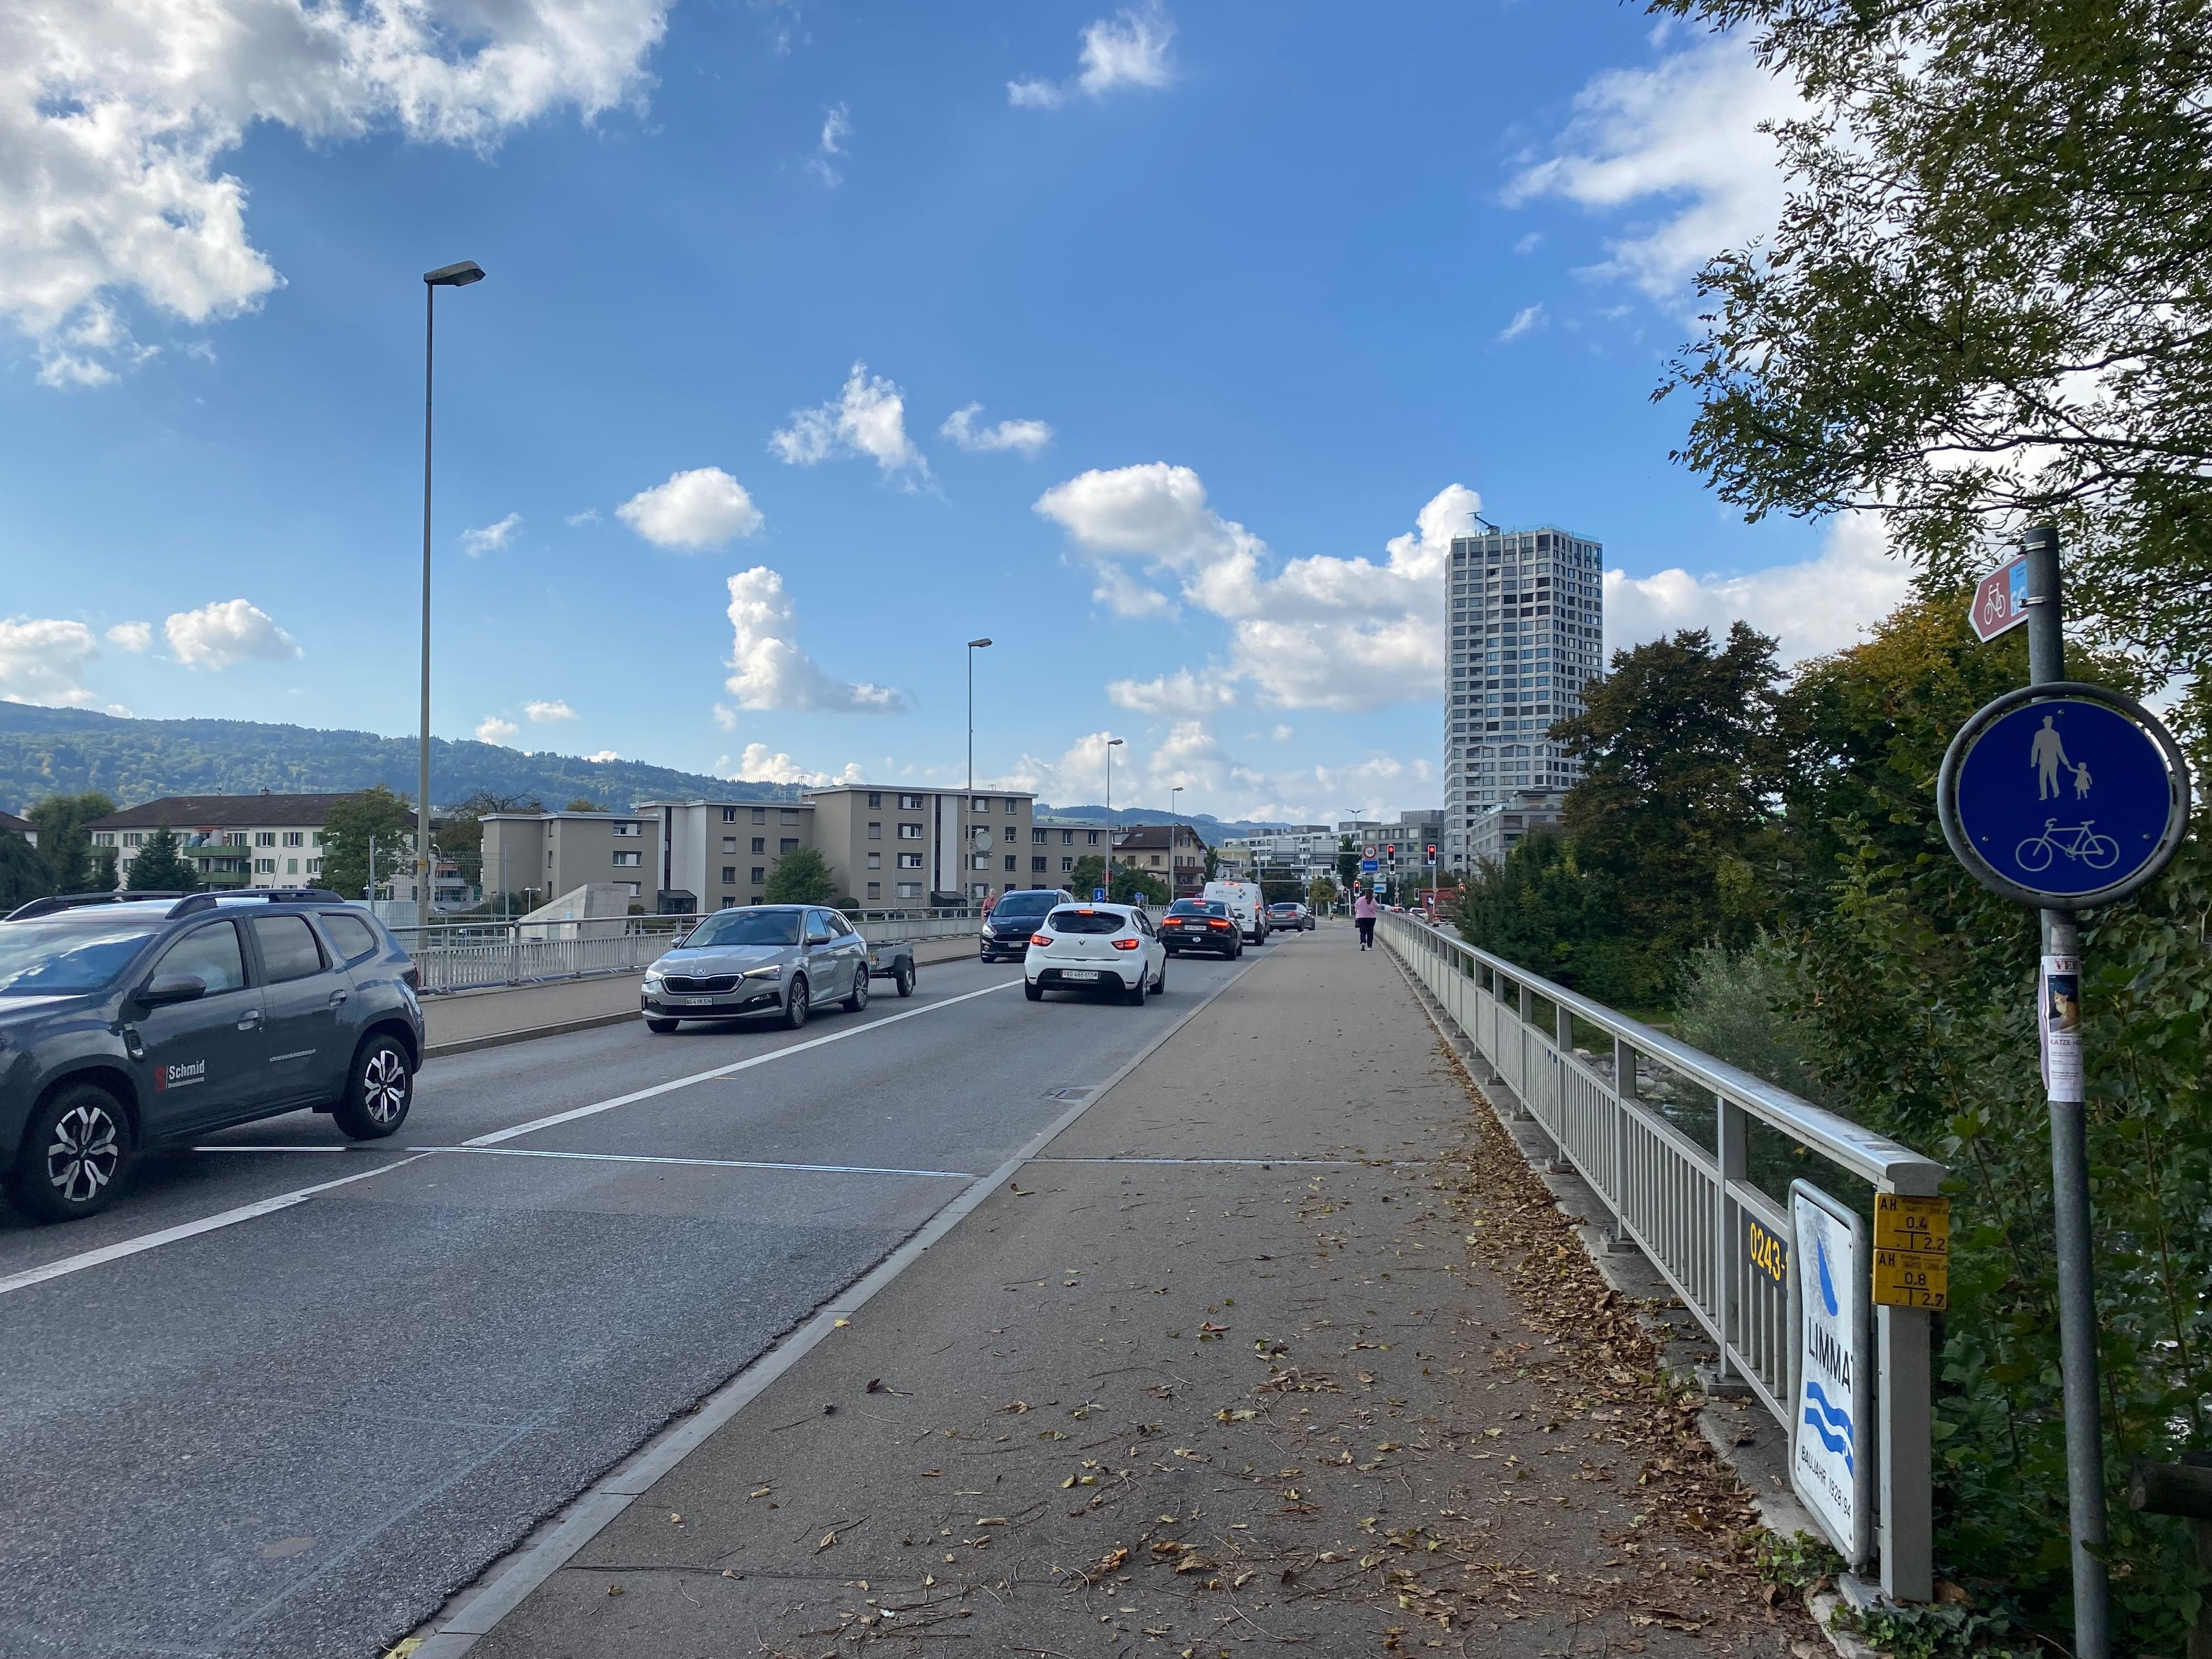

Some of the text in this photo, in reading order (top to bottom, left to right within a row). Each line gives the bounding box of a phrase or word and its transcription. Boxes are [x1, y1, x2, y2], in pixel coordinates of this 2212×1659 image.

[169, 1060, 205, 1079] Schmid
[1880, 1197, 1897, 1211] AH
[1879, 1253, 1895, 1266] AH
[1808, 1316, 1853, 1394] LIMMA
[1801, 1444, 1827, 1487] BAUJAHR
